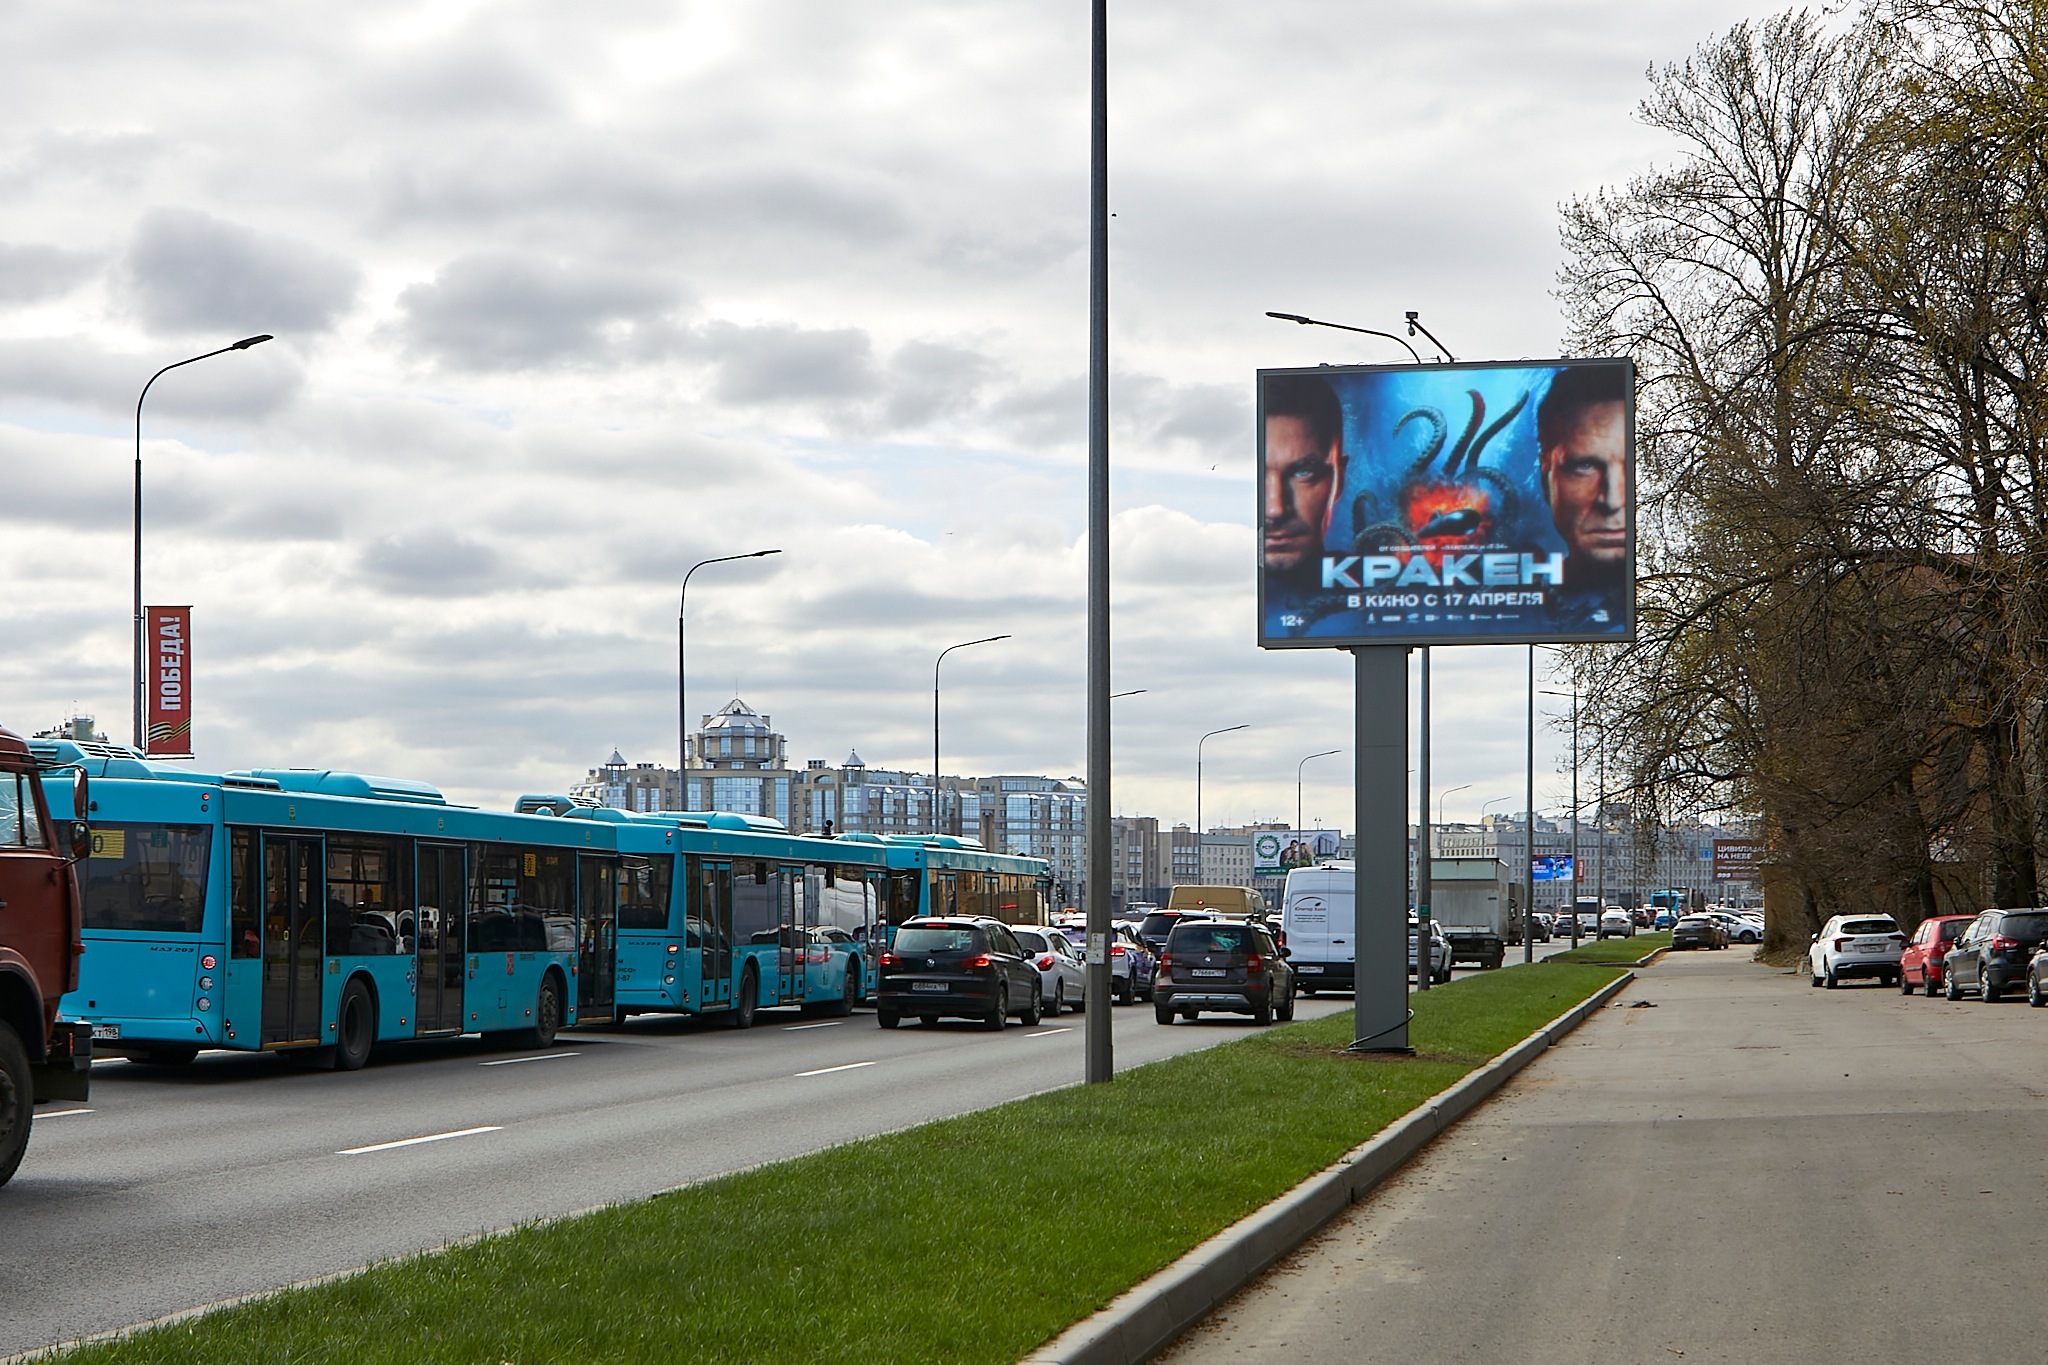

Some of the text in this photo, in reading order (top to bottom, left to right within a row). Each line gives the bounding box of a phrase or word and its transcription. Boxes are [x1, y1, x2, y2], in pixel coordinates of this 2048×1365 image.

[1321, 552, 1563, 588] КРАКЕН
[1347, 592, 1544, 608] В КИНО С 17 АПРЕЛЯ
[1280, 615, 1305, 627] 12+
[160, 616, 184, 711] ПОБЕДА!
